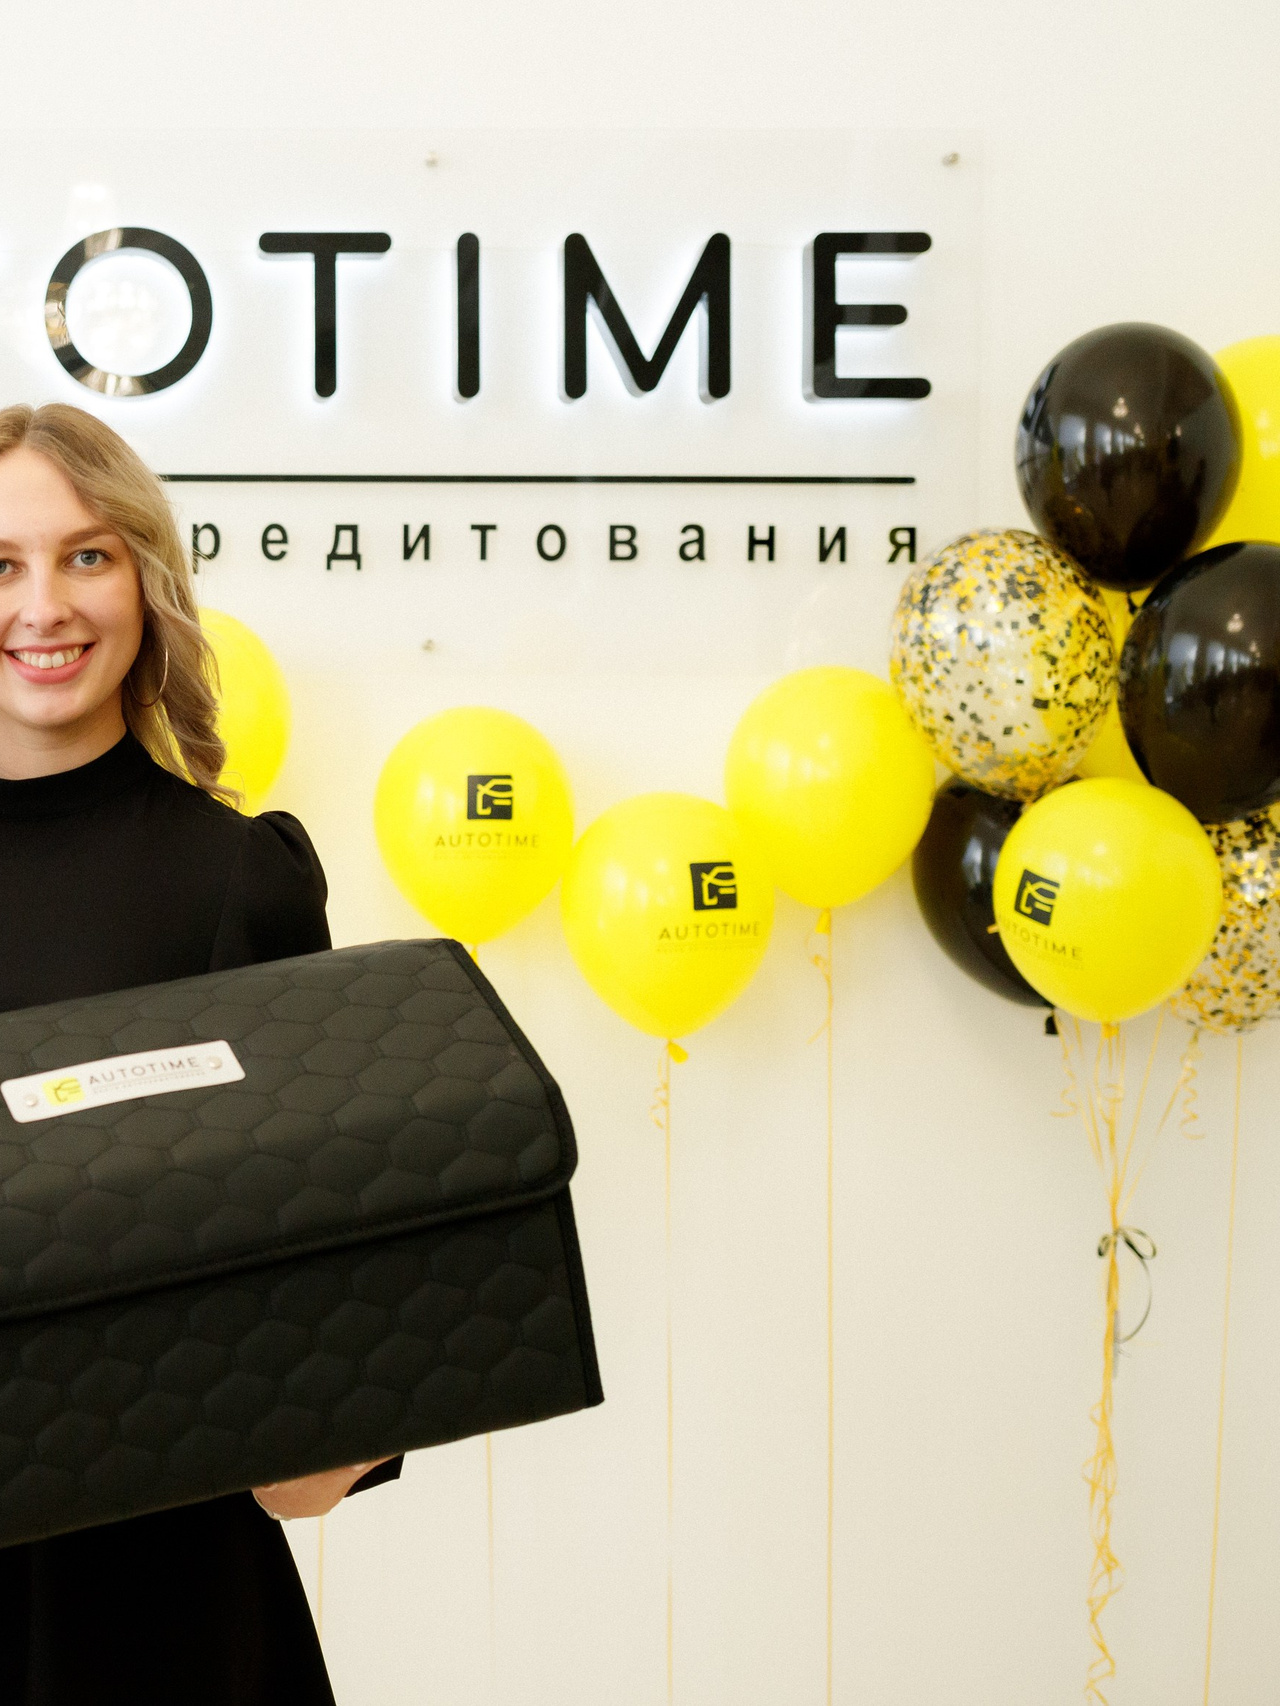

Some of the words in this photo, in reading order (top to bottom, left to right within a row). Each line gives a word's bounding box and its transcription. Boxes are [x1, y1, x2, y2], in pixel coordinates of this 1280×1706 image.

[435, 832, 539, 848] AUTOTIME
[658, 921, 760, 940] AUTOTIME
[88, 1056, 201, 1085] AUTOTIME
